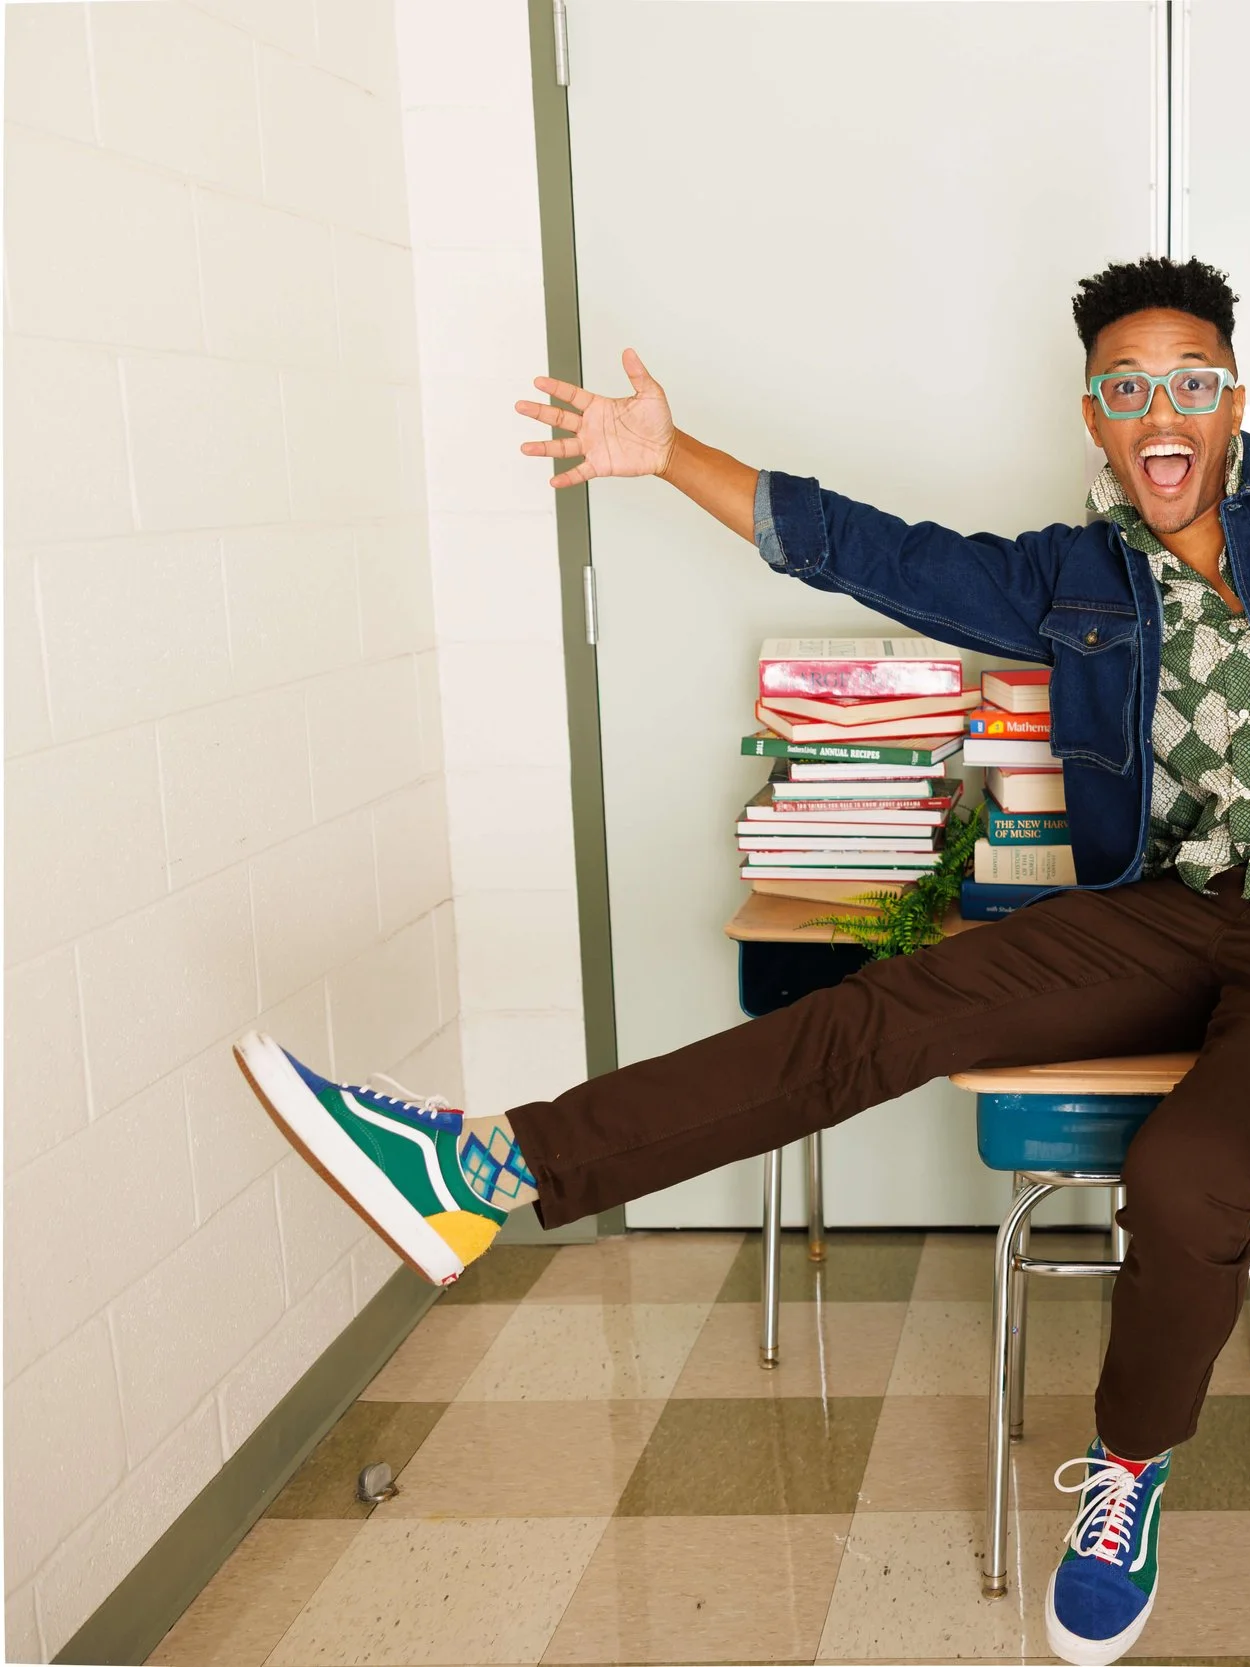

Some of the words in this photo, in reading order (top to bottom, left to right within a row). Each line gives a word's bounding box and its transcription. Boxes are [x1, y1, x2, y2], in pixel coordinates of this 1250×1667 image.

[1006, 721, 1050, 733] Mathema
[755, 740, 764, 755] 2011
[819, 747, 849, 758] ANNUAL
[850, 749, 880, 760] RECIPES
[994, 820, 1015, 829] THE
[1017, 820, 1040, 829] NEW
[1043, 820, 1069, 829] HARV
[994, 829, 1008, 838] OF
[1010, 829, 1041, 838] MUSIC
